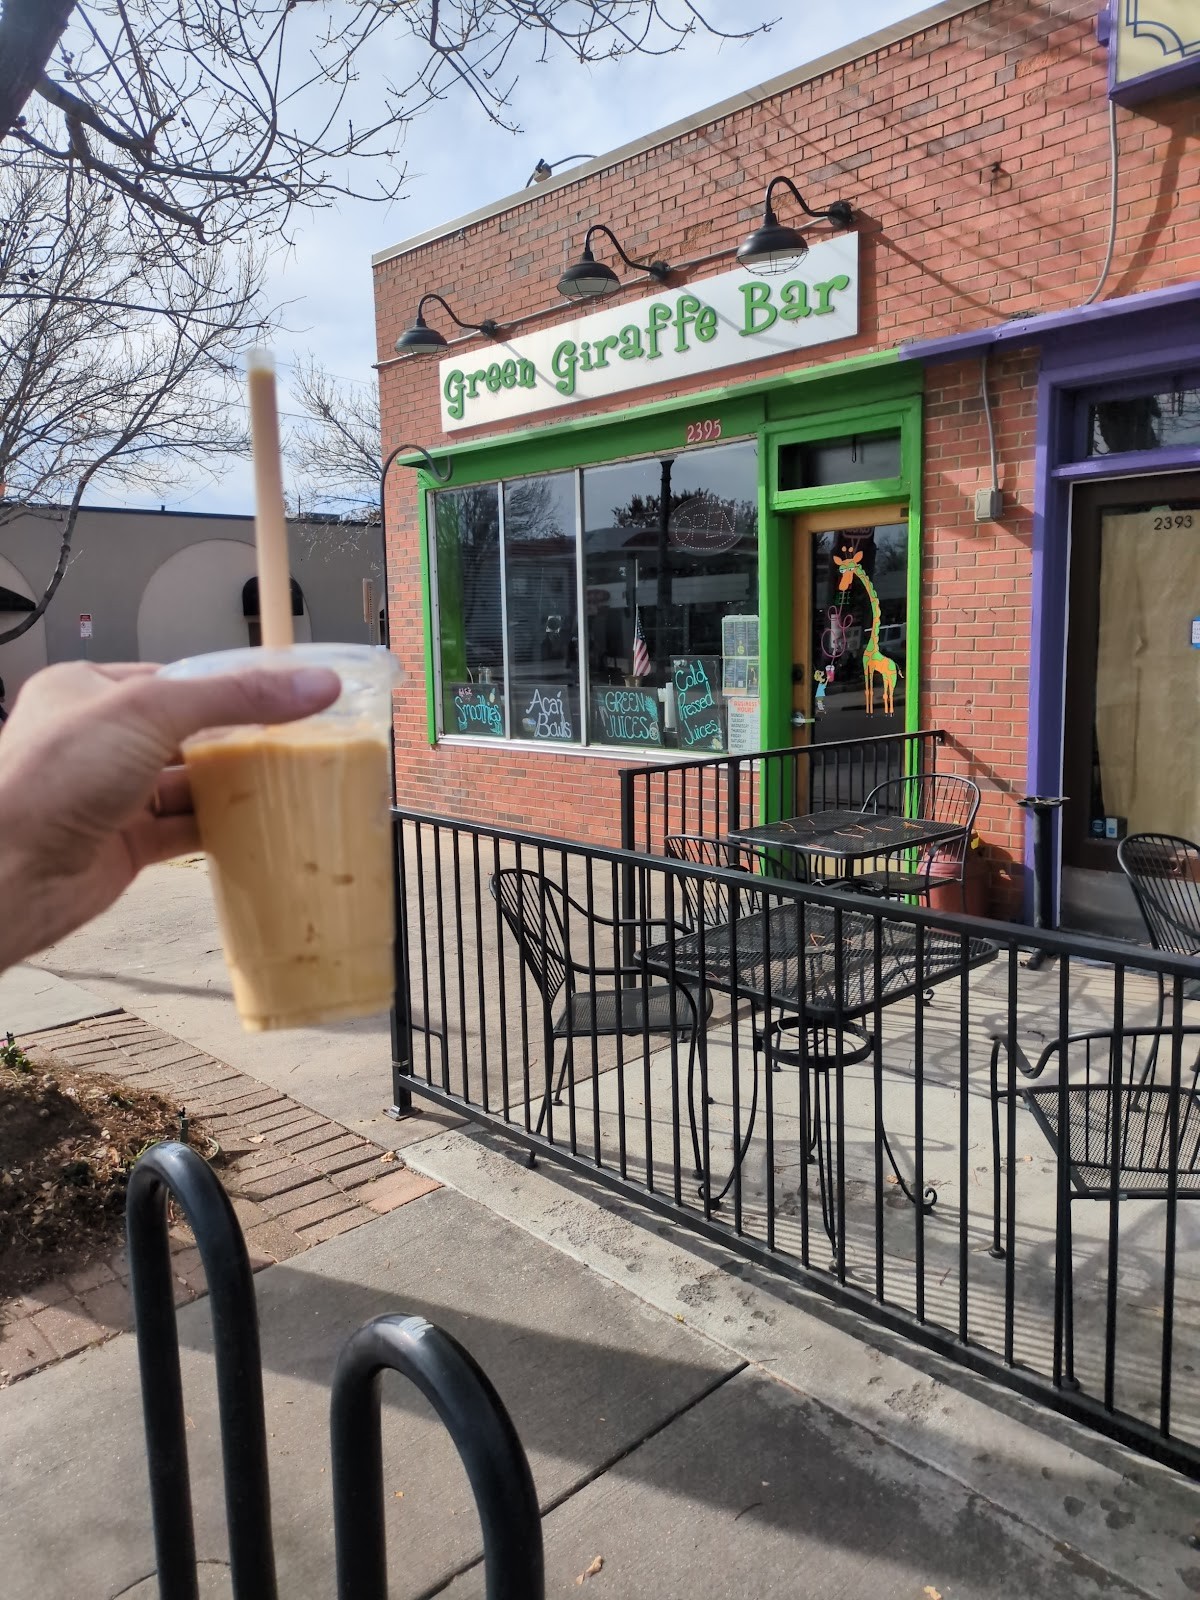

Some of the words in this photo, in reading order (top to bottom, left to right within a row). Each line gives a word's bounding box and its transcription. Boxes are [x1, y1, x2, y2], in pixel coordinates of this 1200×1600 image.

[444, 357, 536, 419] Green
[551, 294, 718, 396] Giraffe
[738, 274, 850, 337] Bar
[687, 419, 722, 443] 2395
[675, 507, 736, 542] OPEN
[1153, 515, 1193, 531] 2393
[675, 659, 709, 692] Cold
[454, 694, 502, 726] Smoothies
[605, 691, 646, 713] GREEN
[677, 680, 715, 721] Pressed
[606, 715, 651, 740] JUICES
[683, 719, 718, 745] Juices
